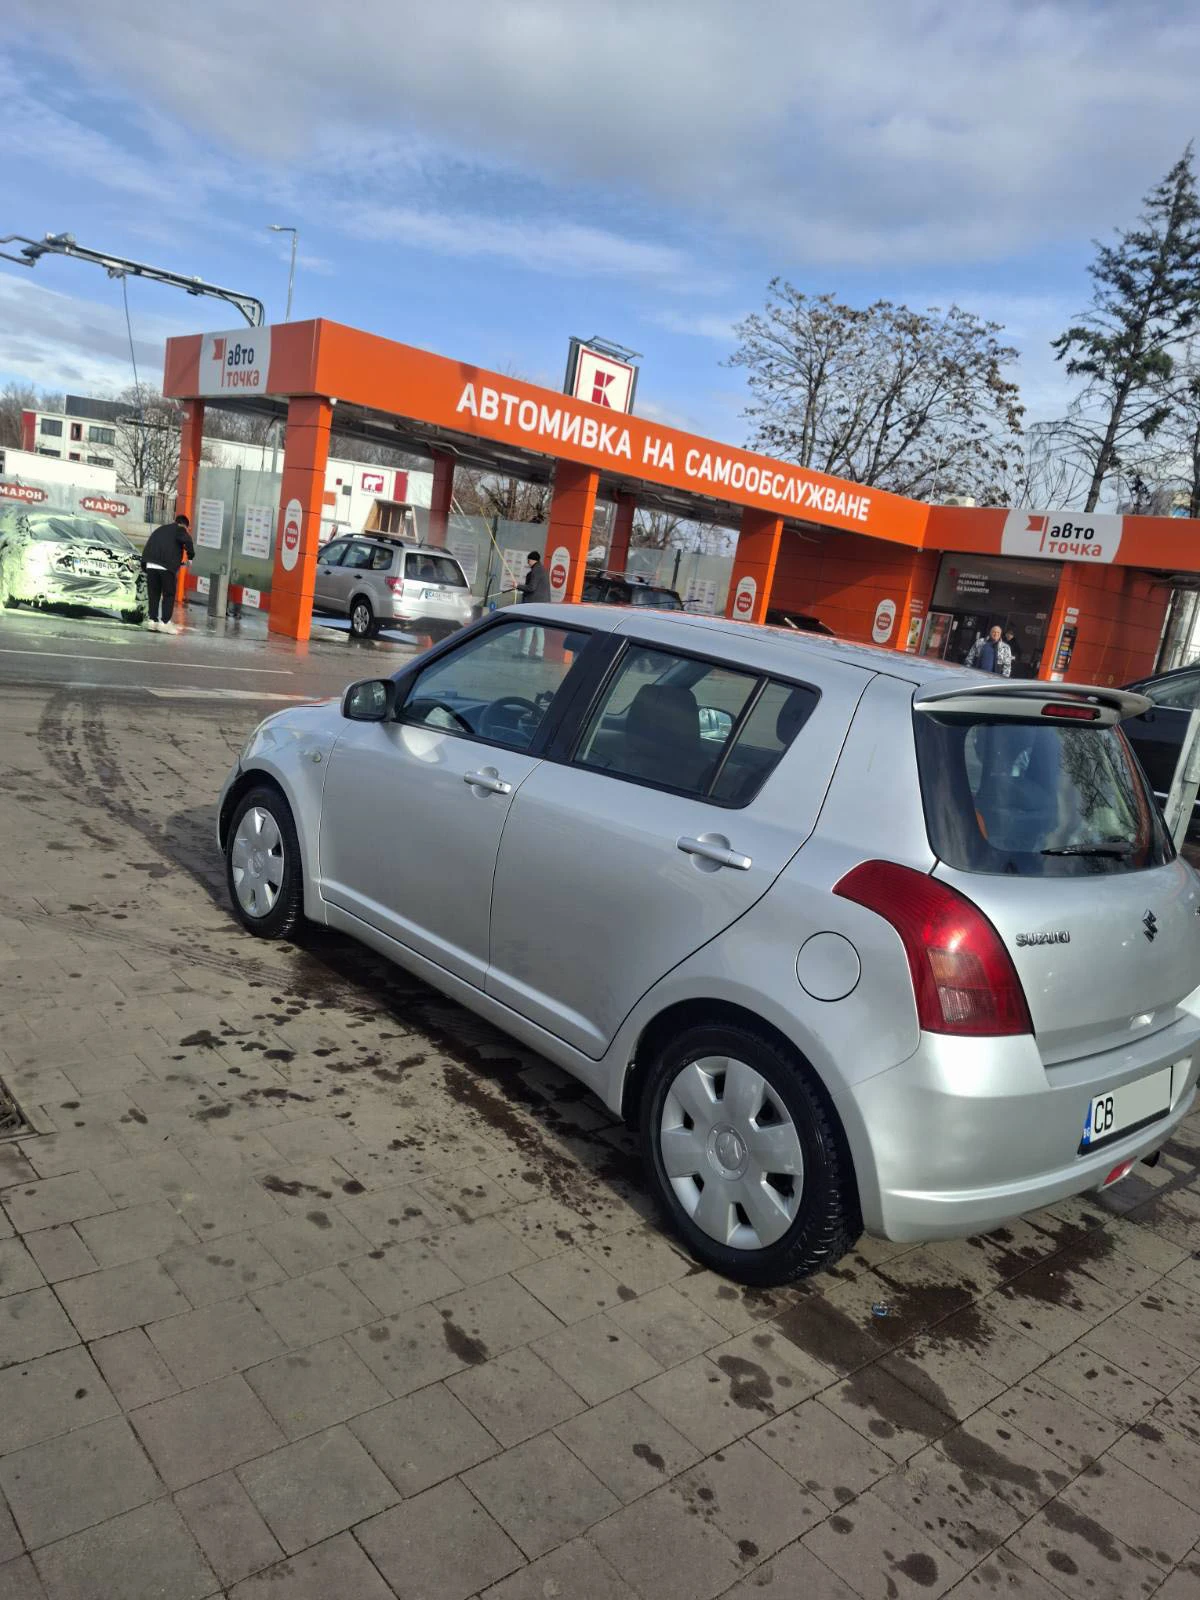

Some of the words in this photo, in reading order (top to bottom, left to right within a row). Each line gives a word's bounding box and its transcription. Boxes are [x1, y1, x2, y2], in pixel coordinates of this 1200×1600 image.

[227, 344, 255, 366] авто
[226, 369, 260, 387] точка
[456, 383, 632, 460] АВТОМИВКА
[642, 436, 675, 471] НА
[685, 449, 872, 522] САМООБСЛУЖВАНЕ
[85, 500, 126, 513] МАРОН
[1050, 523, 1095, 540] авто
[1048, 541, 1103, 557] точка
[1015, 930, 1071, 947] SUZUKI
